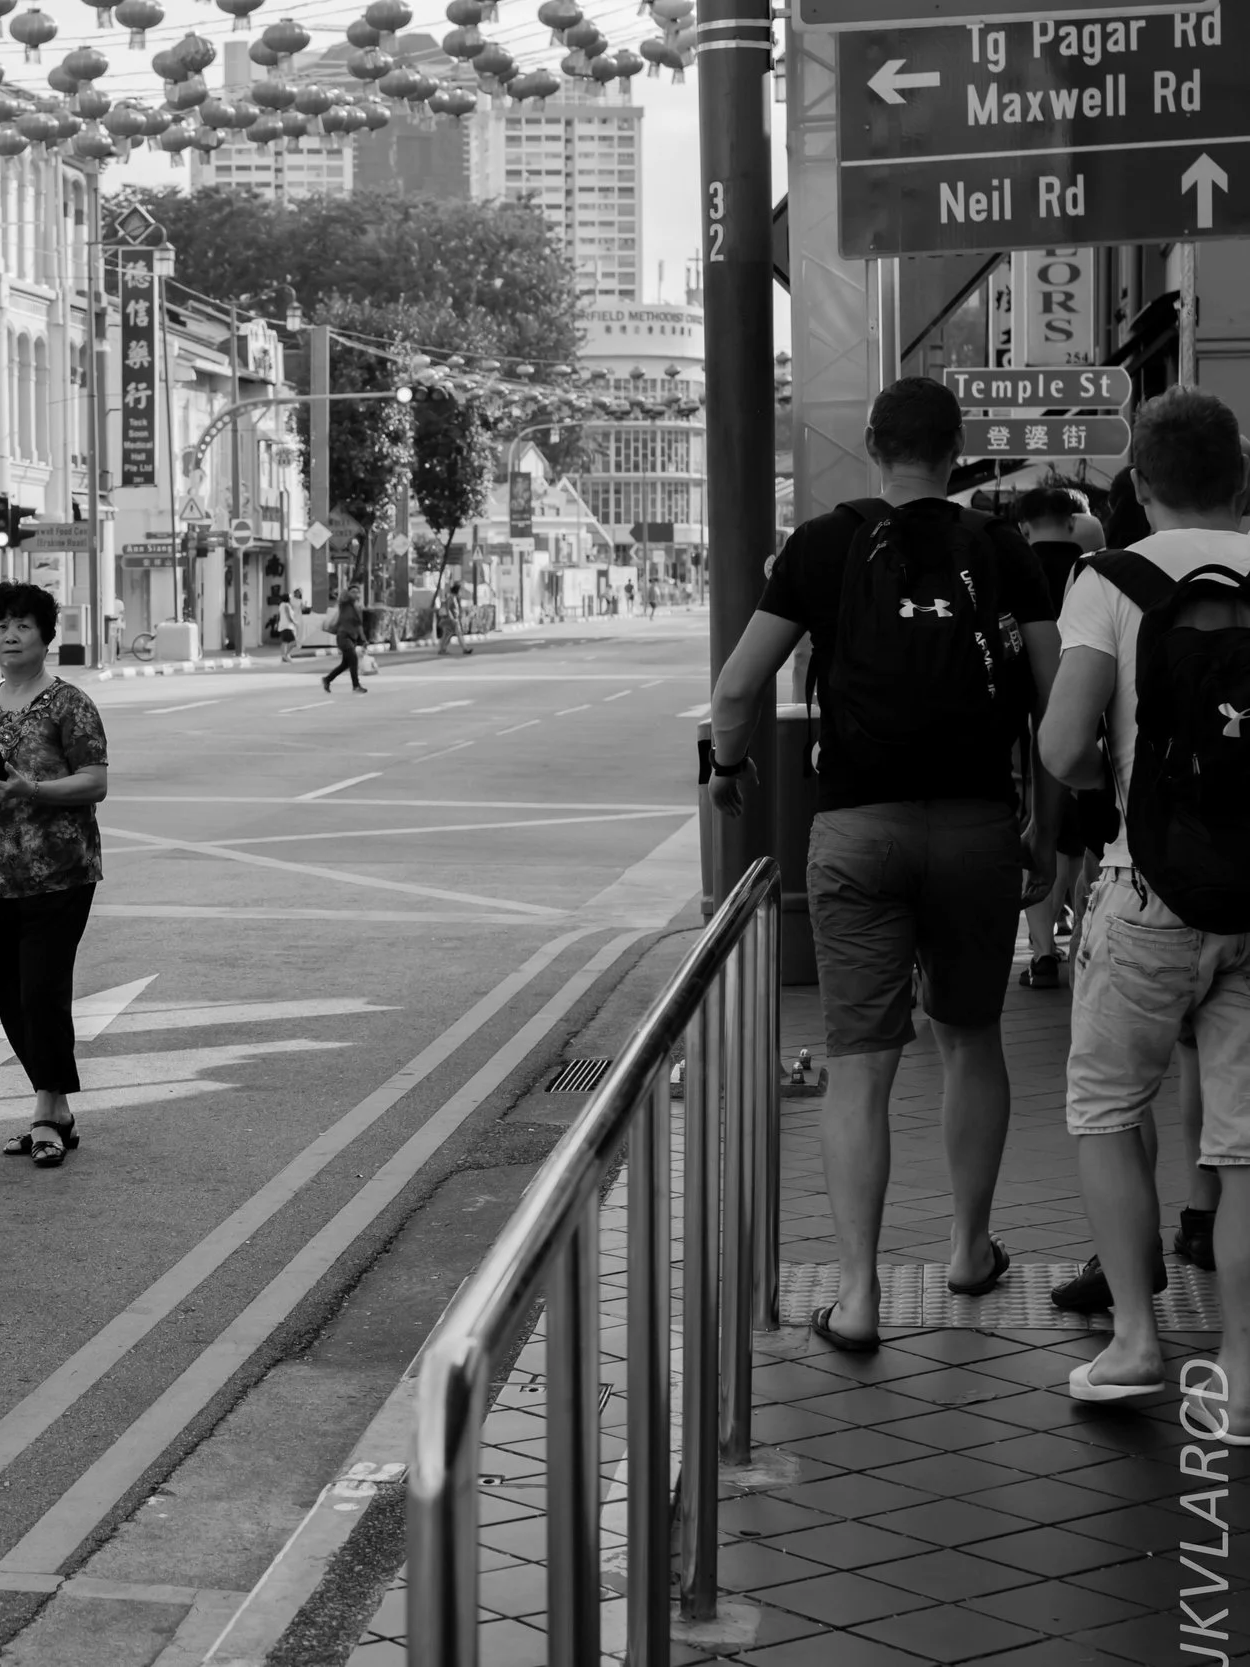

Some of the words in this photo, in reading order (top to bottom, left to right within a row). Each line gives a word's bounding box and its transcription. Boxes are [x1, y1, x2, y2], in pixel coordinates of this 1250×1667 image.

[966, 23, 1006, 73] Tg
[1033, 19, 1146, 66] Pagar
[1174, 6, 1222, 48] Rd
[967, 73, 1126, 126] Maxwell
[1154, 68, 1201, 114] Rd
[940, 177, 1012, 224] Neil
[1038, 173, 1086, 218] Rd
[1065, 351, 1089, 365] 254
[954, 373, 1064, 404] Temple
[1079, 373, 1111, 398] St
[987, 425, 1086, 450] 登婆街
